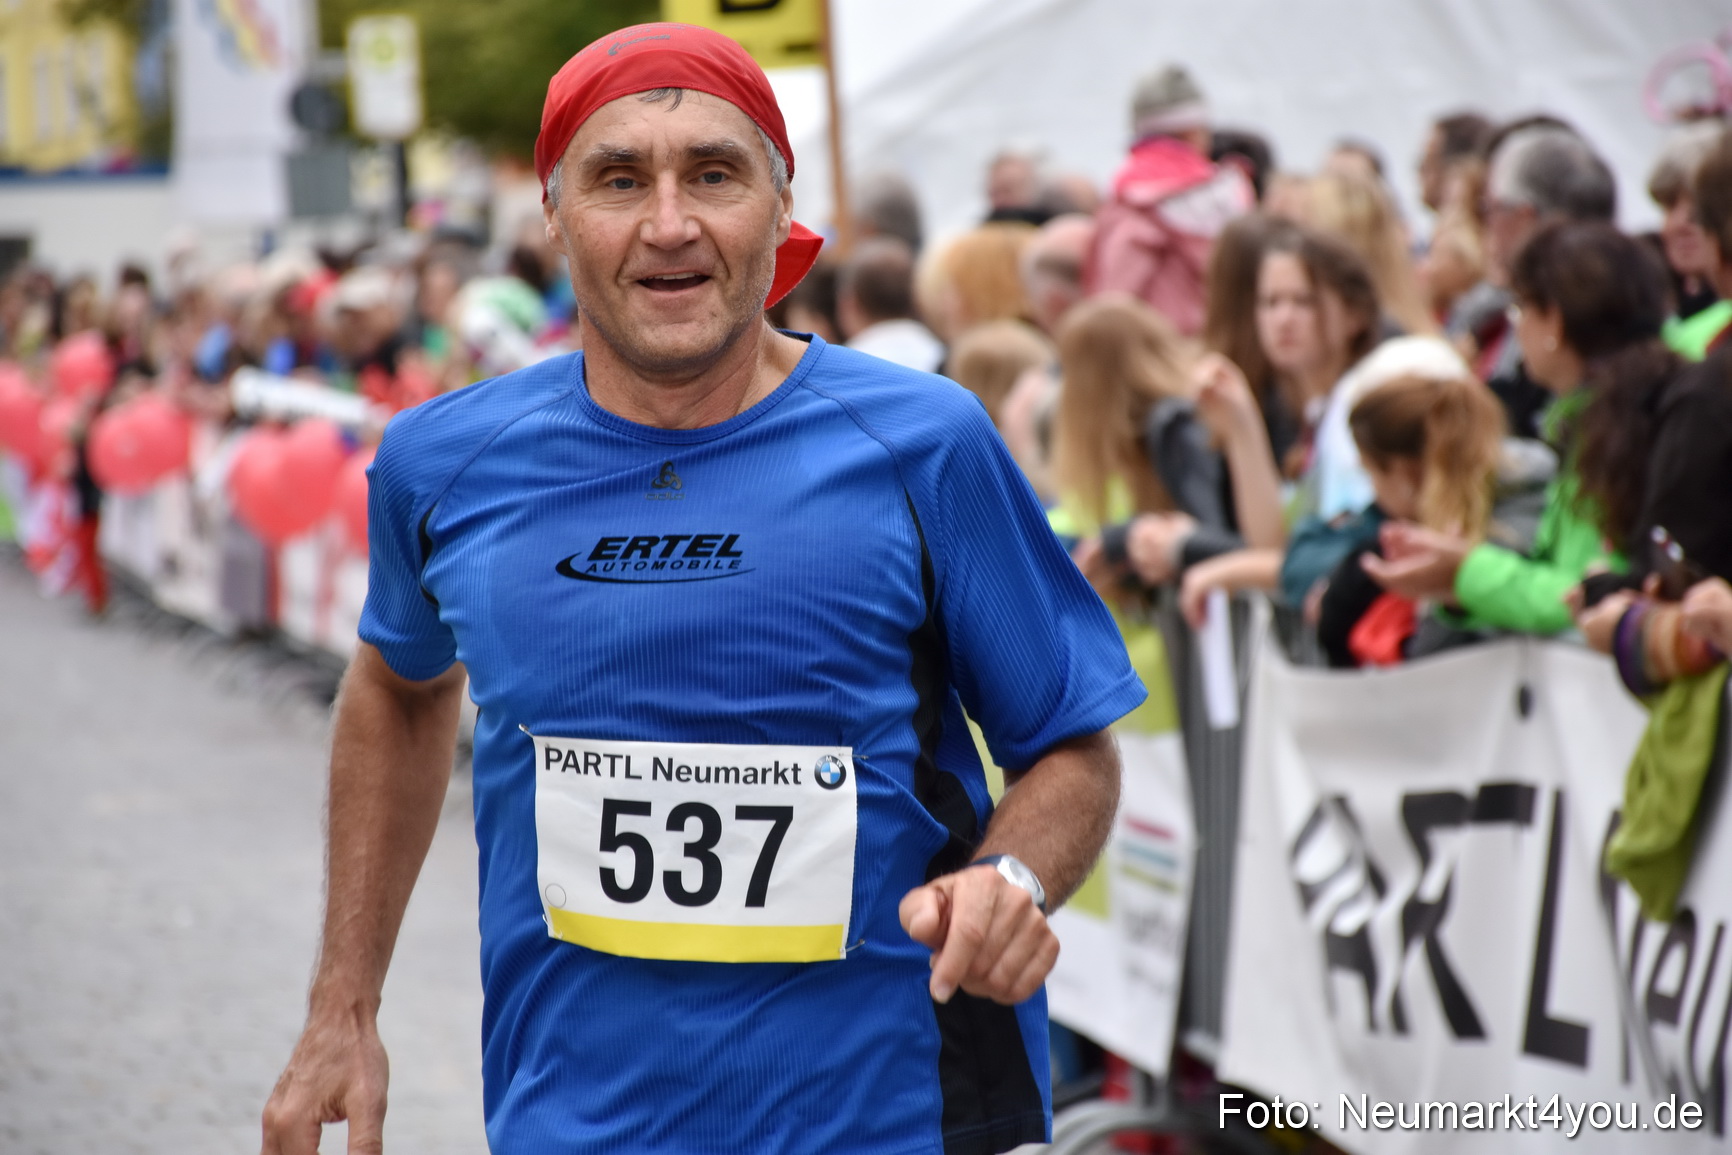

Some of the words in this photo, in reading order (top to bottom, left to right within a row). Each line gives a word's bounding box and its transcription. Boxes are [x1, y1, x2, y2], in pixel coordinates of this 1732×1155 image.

[587, 533, 744, 561] ERTEL
[585, 560, 742, 574] AUTOMOBILE
[544, 745, 642, 780] PARTL
[652, 756, 802, 785] Neumarkt
[599, 797, 794, 907] 537
